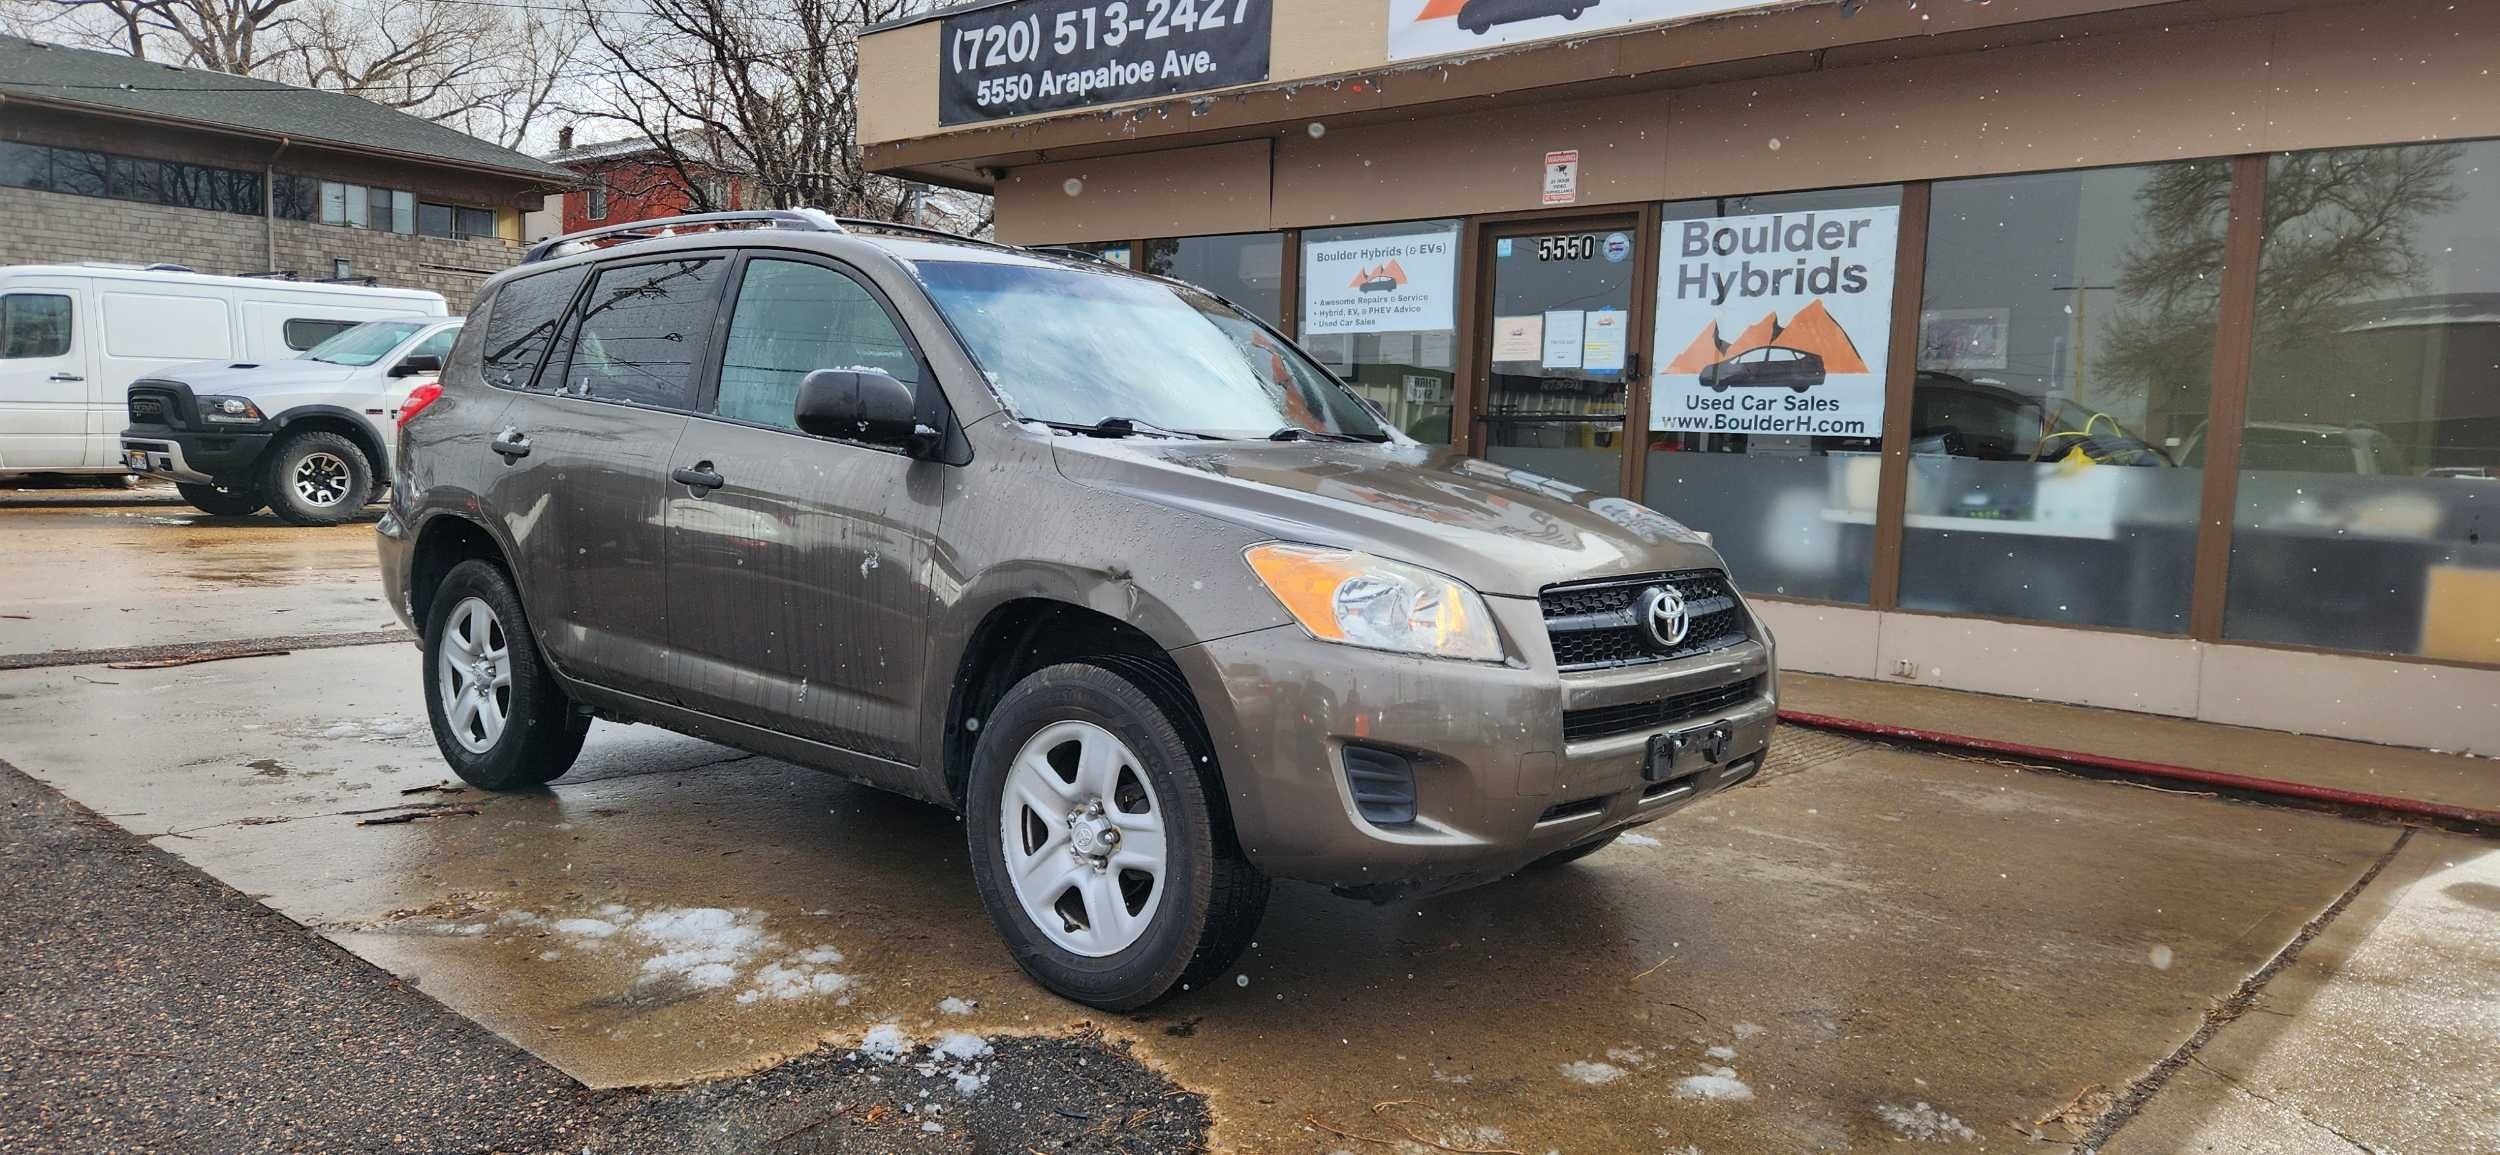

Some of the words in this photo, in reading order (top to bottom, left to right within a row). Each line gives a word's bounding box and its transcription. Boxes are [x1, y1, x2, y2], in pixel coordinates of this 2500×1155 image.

[953, 14, 1040, 75] (720)
[976, 73, 1033, 107] 5550
[1039, 59, 1155, 97] Arapahoe
[1161, 49, 1218, 79] Ave.
[1681, 213, 1872, 258] Boulder
[1316, 251, 1357, 262] Boulder
[1360, 246, 1402, 260] Hybrids
[1419, 242, 1447, 255] EVs)
[1538, 235, 1596, 261] 5550
[1677, 256, 1868, 306] Hybrids
[1358, 296, 1388, 305] Repairs
[1398, 294, 1429, 302] Service
[1394, 305, 1422, 313] Advice
[1340, 319, 1353, 327] Car
[1686, 395, 1735, 411] Used
[1741, 395, 1777, 411] Car
[1783, 395, 1840, 411] Sales
[1662, 413, 1866, 434] www.BoulderH.com
